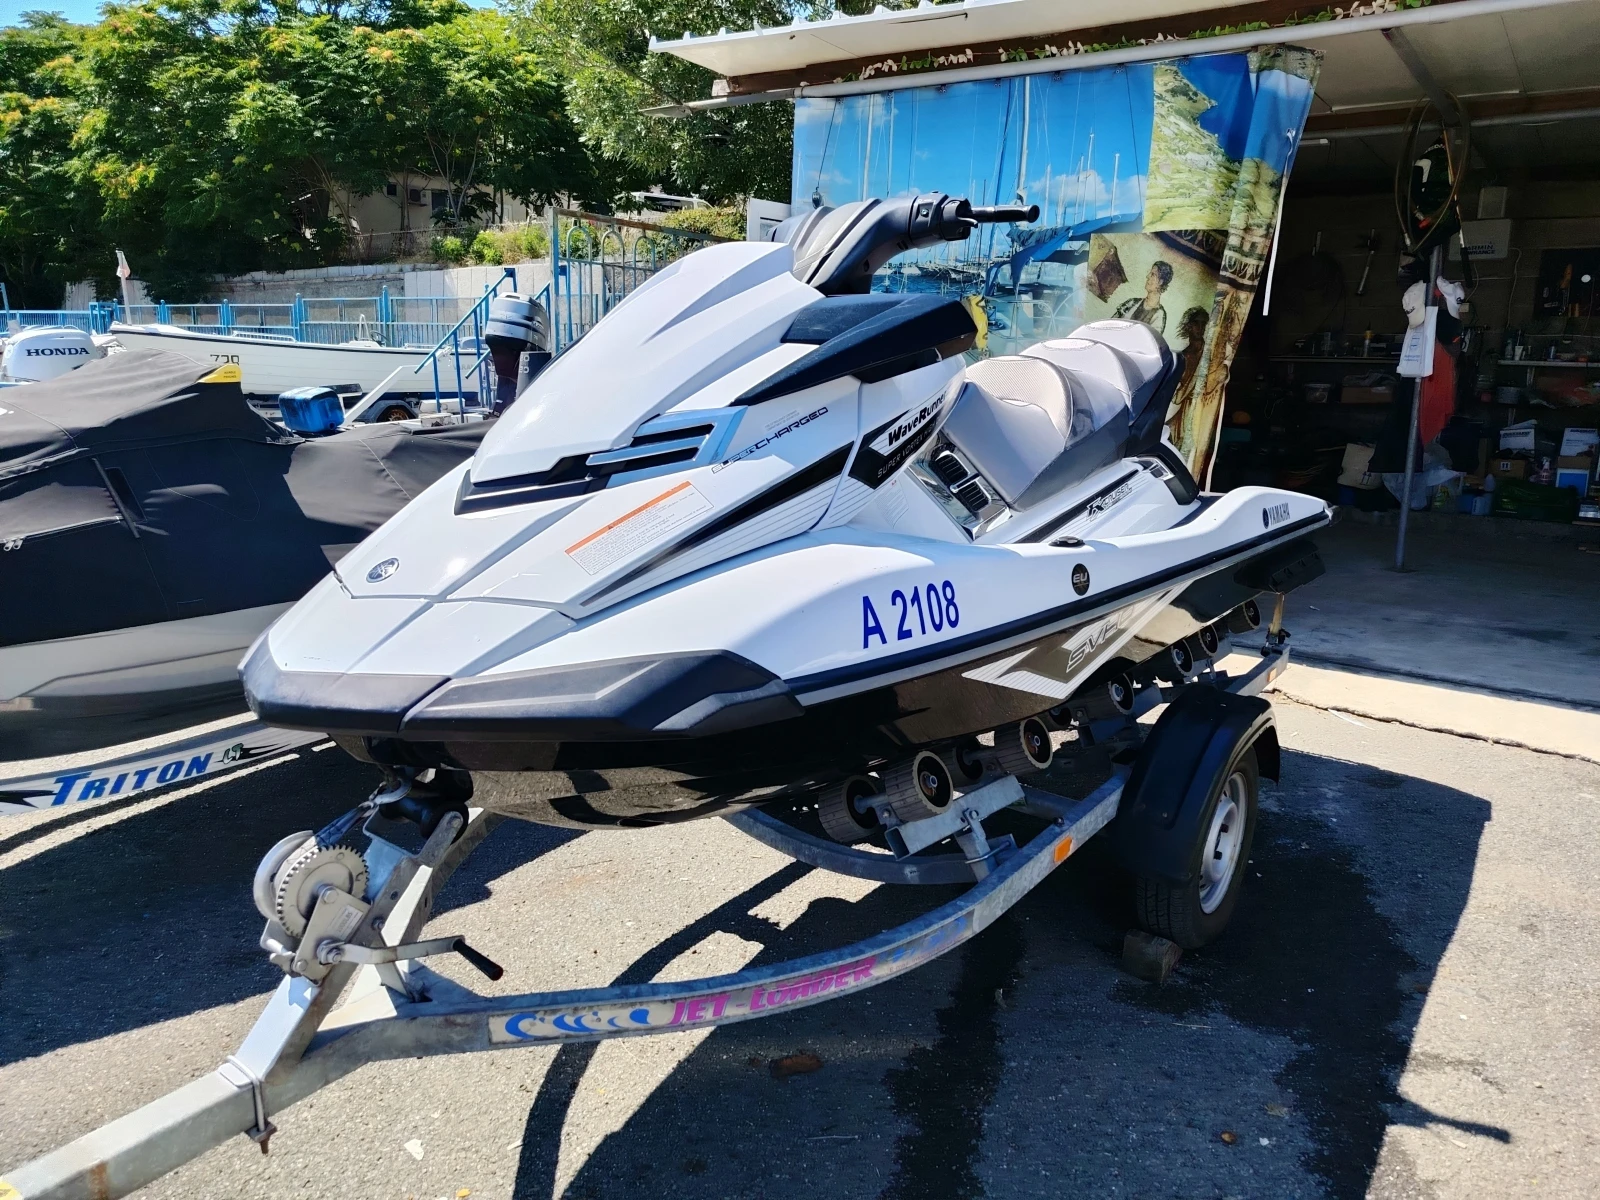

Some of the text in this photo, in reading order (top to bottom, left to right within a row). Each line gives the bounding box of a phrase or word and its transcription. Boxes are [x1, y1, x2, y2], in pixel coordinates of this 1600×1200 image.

[26, 348, 90, 356] HONDA
[888, 391, 946, 447] WaveRunner
[711, 406, 828, 474] SUPERCHARGED
[878, 454, 901, 478] SUPER
[1267, 502, 1290, 526] YAMAHA
[1073, 572, 1088, 583] EU
[863, 580, 959, 649] A 2108
[51, 743, 244, 806] TRITON LT
